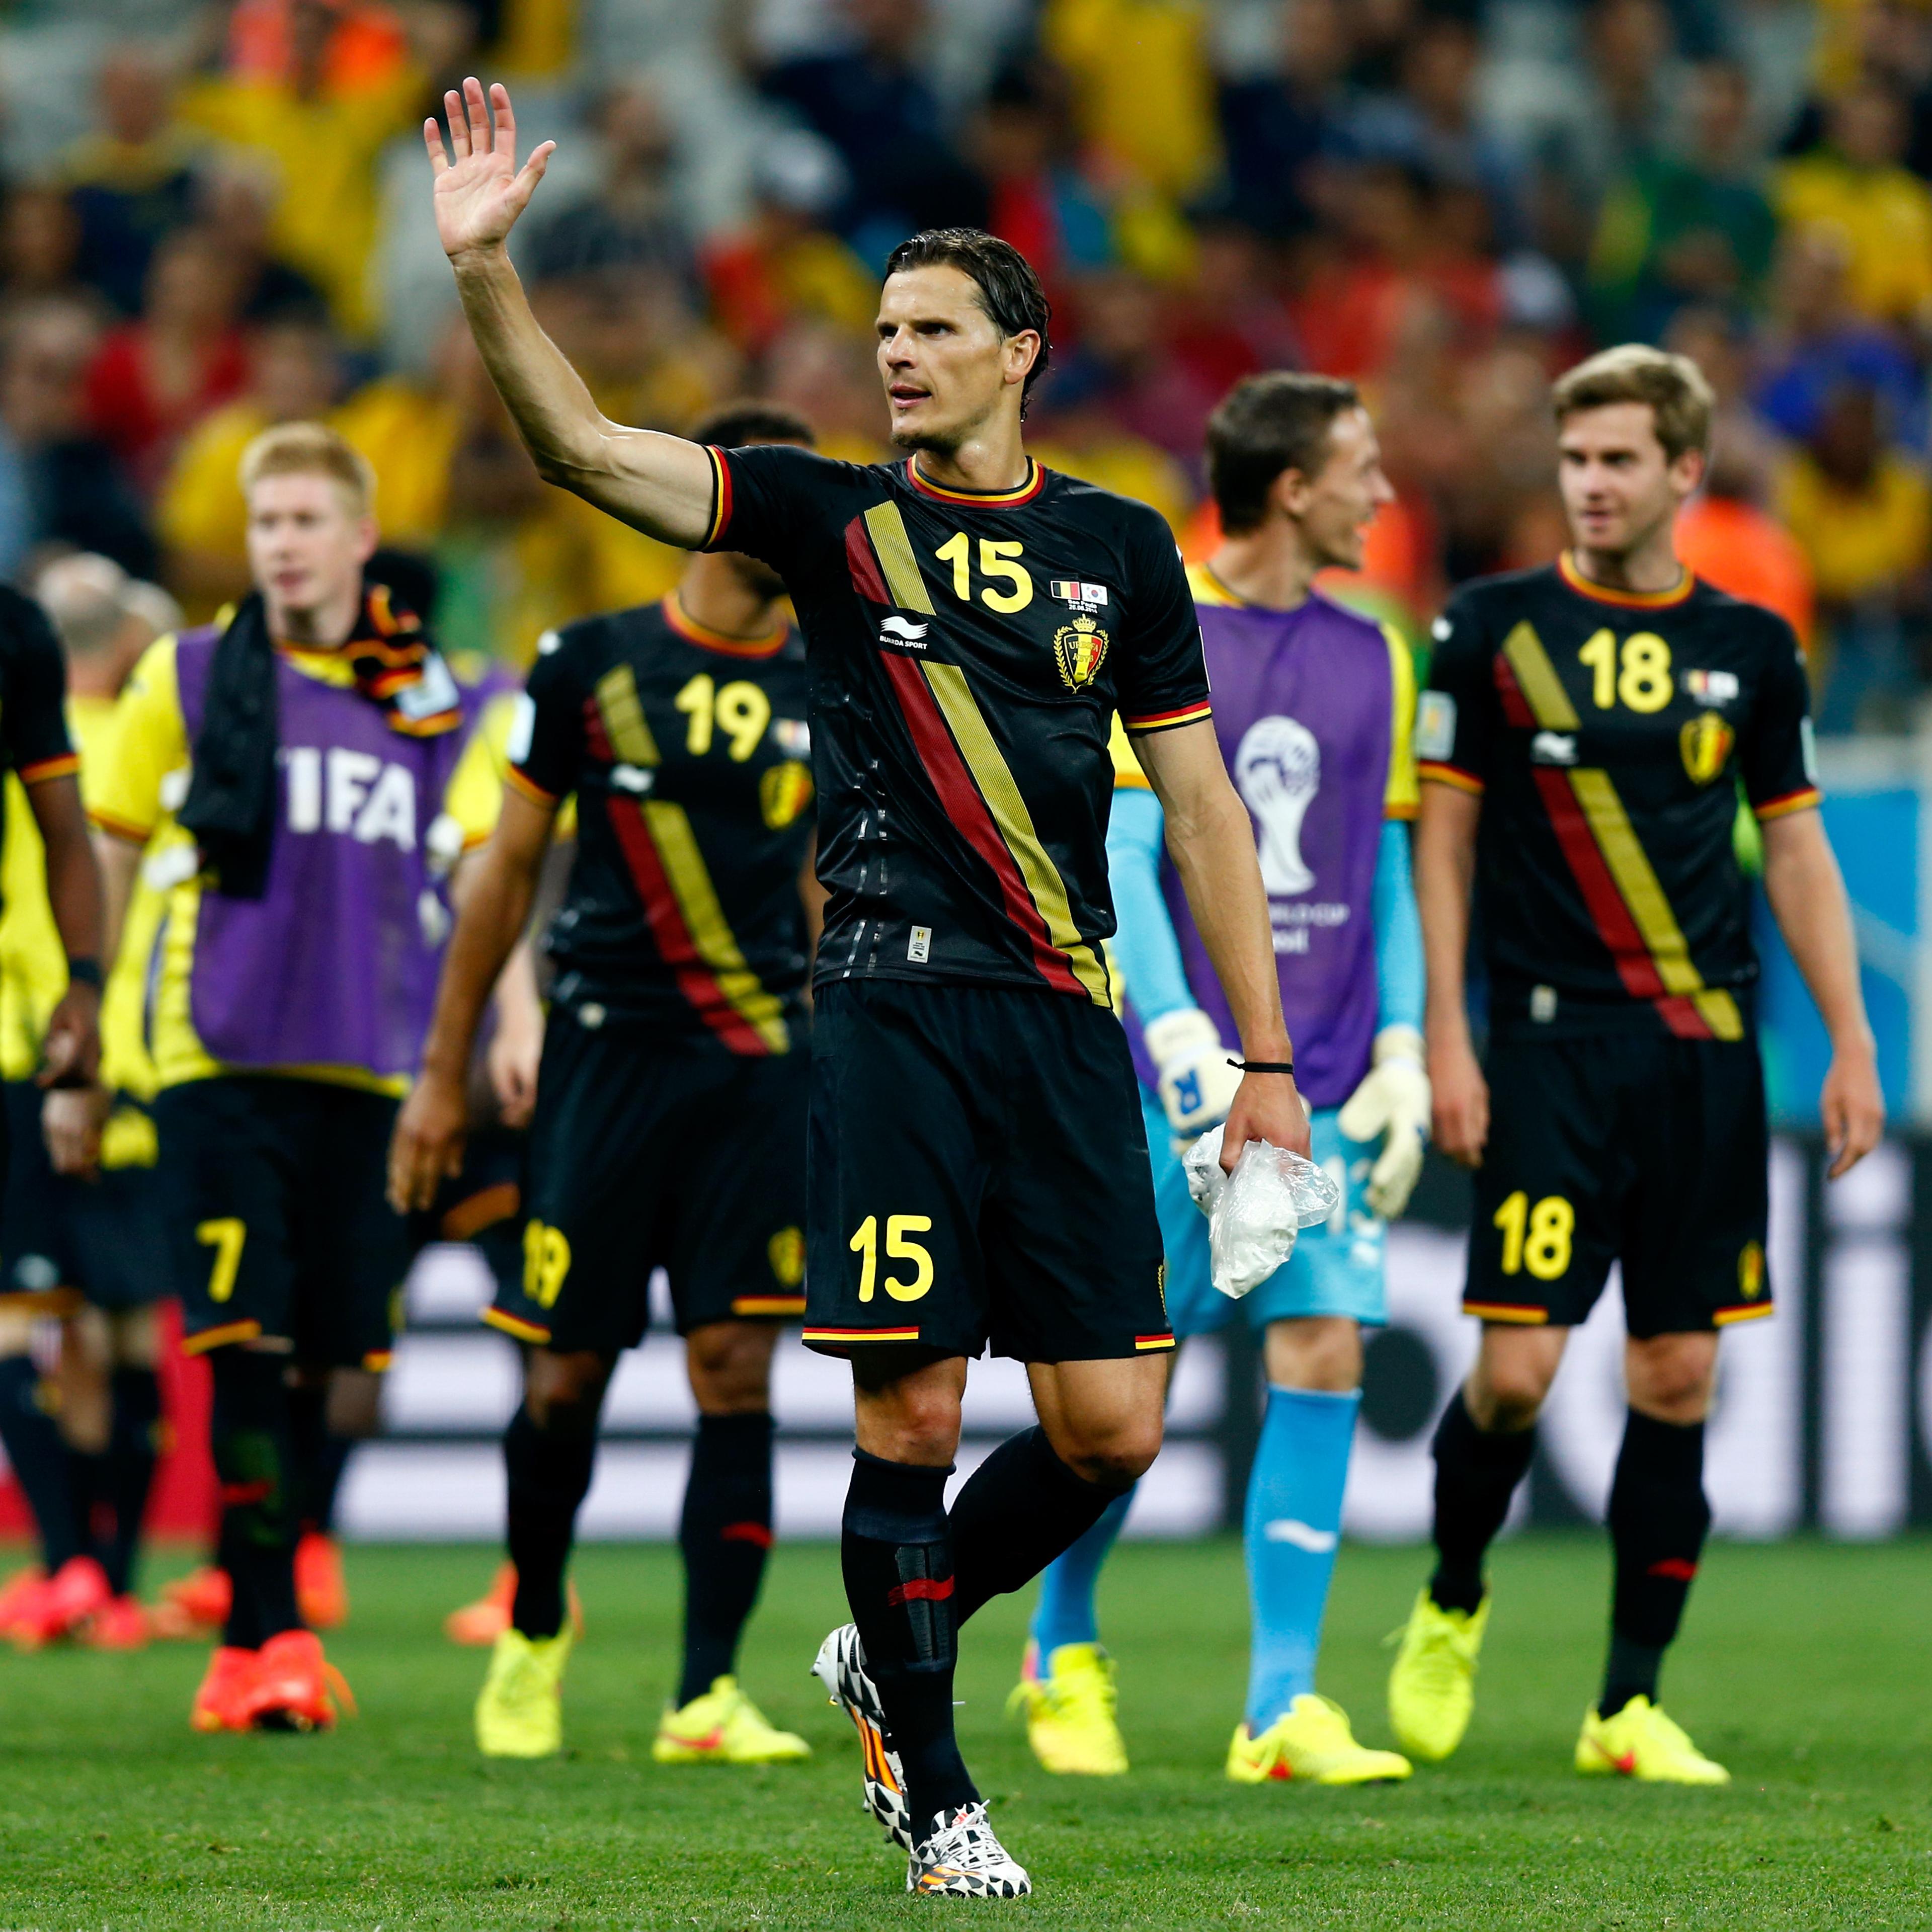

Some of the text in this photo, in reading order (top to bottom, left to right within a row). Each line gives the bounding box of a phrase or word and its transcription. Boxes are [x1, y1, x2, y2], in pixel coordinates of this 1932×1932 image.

[935, 532, 1033, 613] 15
[879, 635, 928, 650] BURRDA SPORT
[1578, 627, 1674, 713] 18
[674, 673, 771, 763] 19
[277, 746, 417, 852] IFA
[196, 1216, 247, 1303] 7
[523, 1219, 571, 1308] 19
[850, 1215, 934, 1302] 15
[1494, 1190, 1575, 1280] 18
